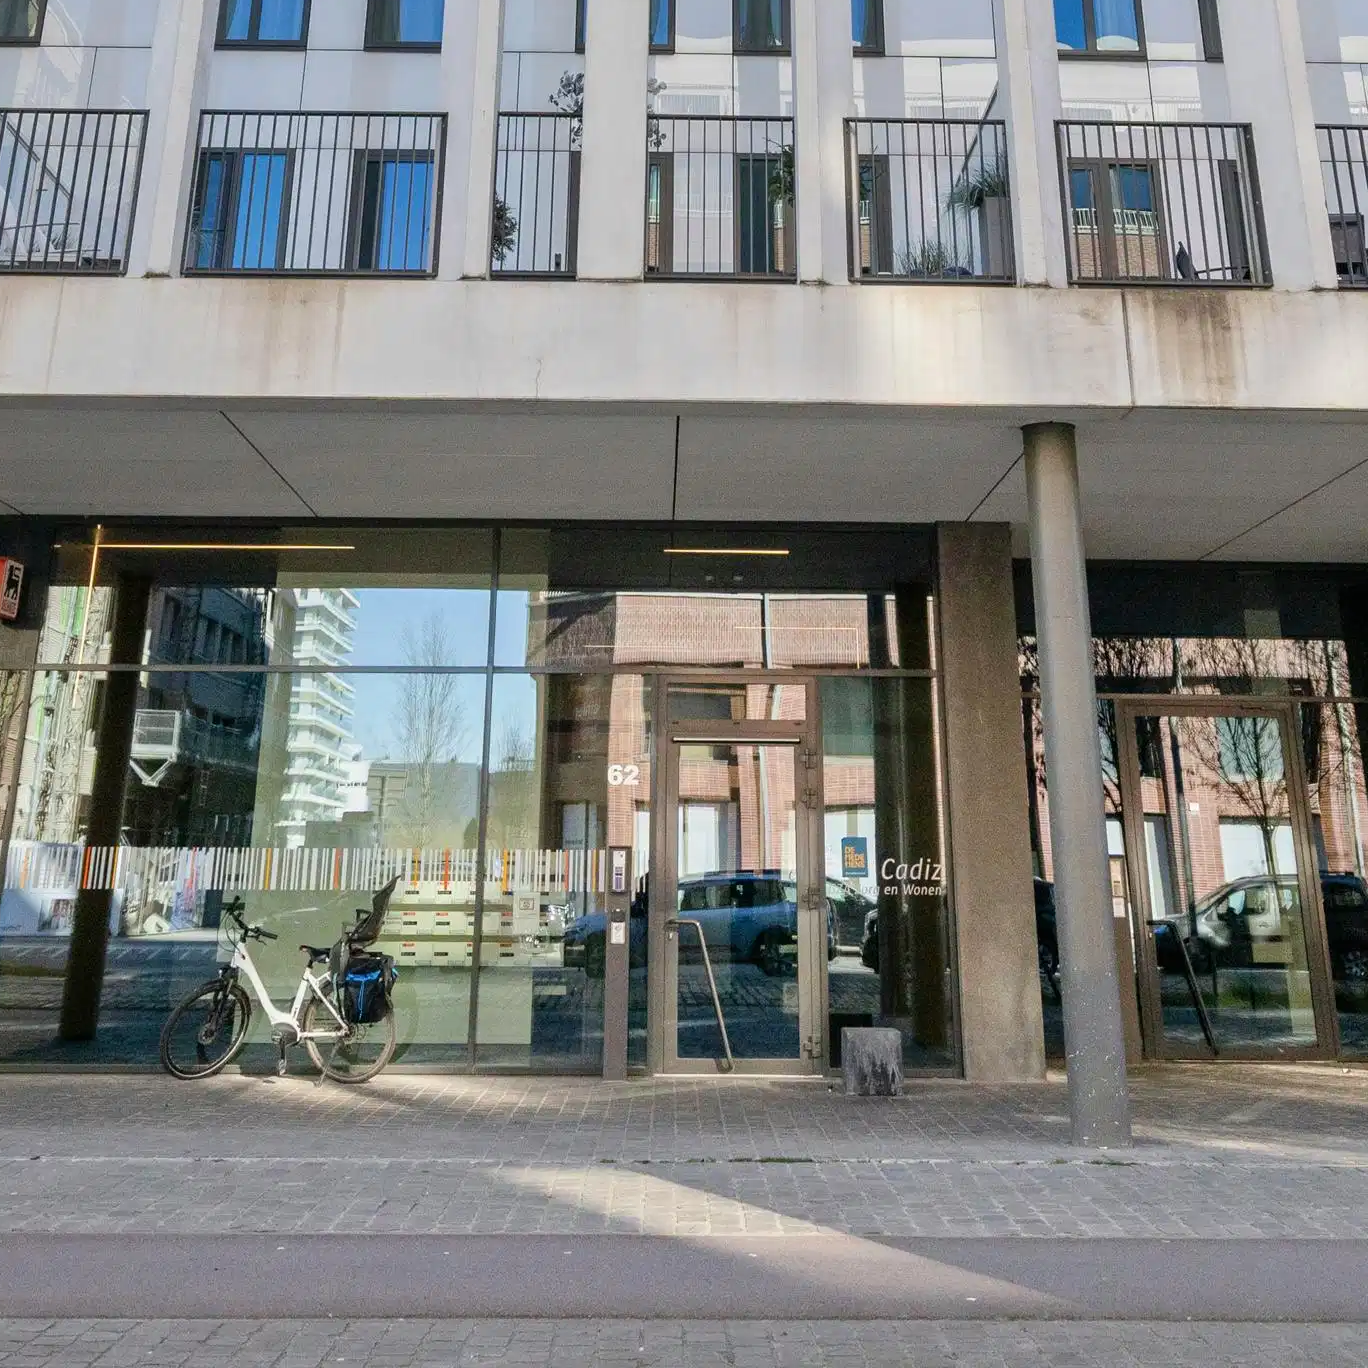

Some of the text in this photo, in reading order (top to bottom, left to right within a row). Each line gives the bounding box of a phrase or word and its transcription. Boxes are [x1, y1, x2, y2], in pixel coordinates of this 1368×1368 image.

[607, 764, 640, 786] 62
[881, 857, 944, 881] Cadiz
[883, 886, 898, 896] en
[902, 884, 943, 896] Wonen
